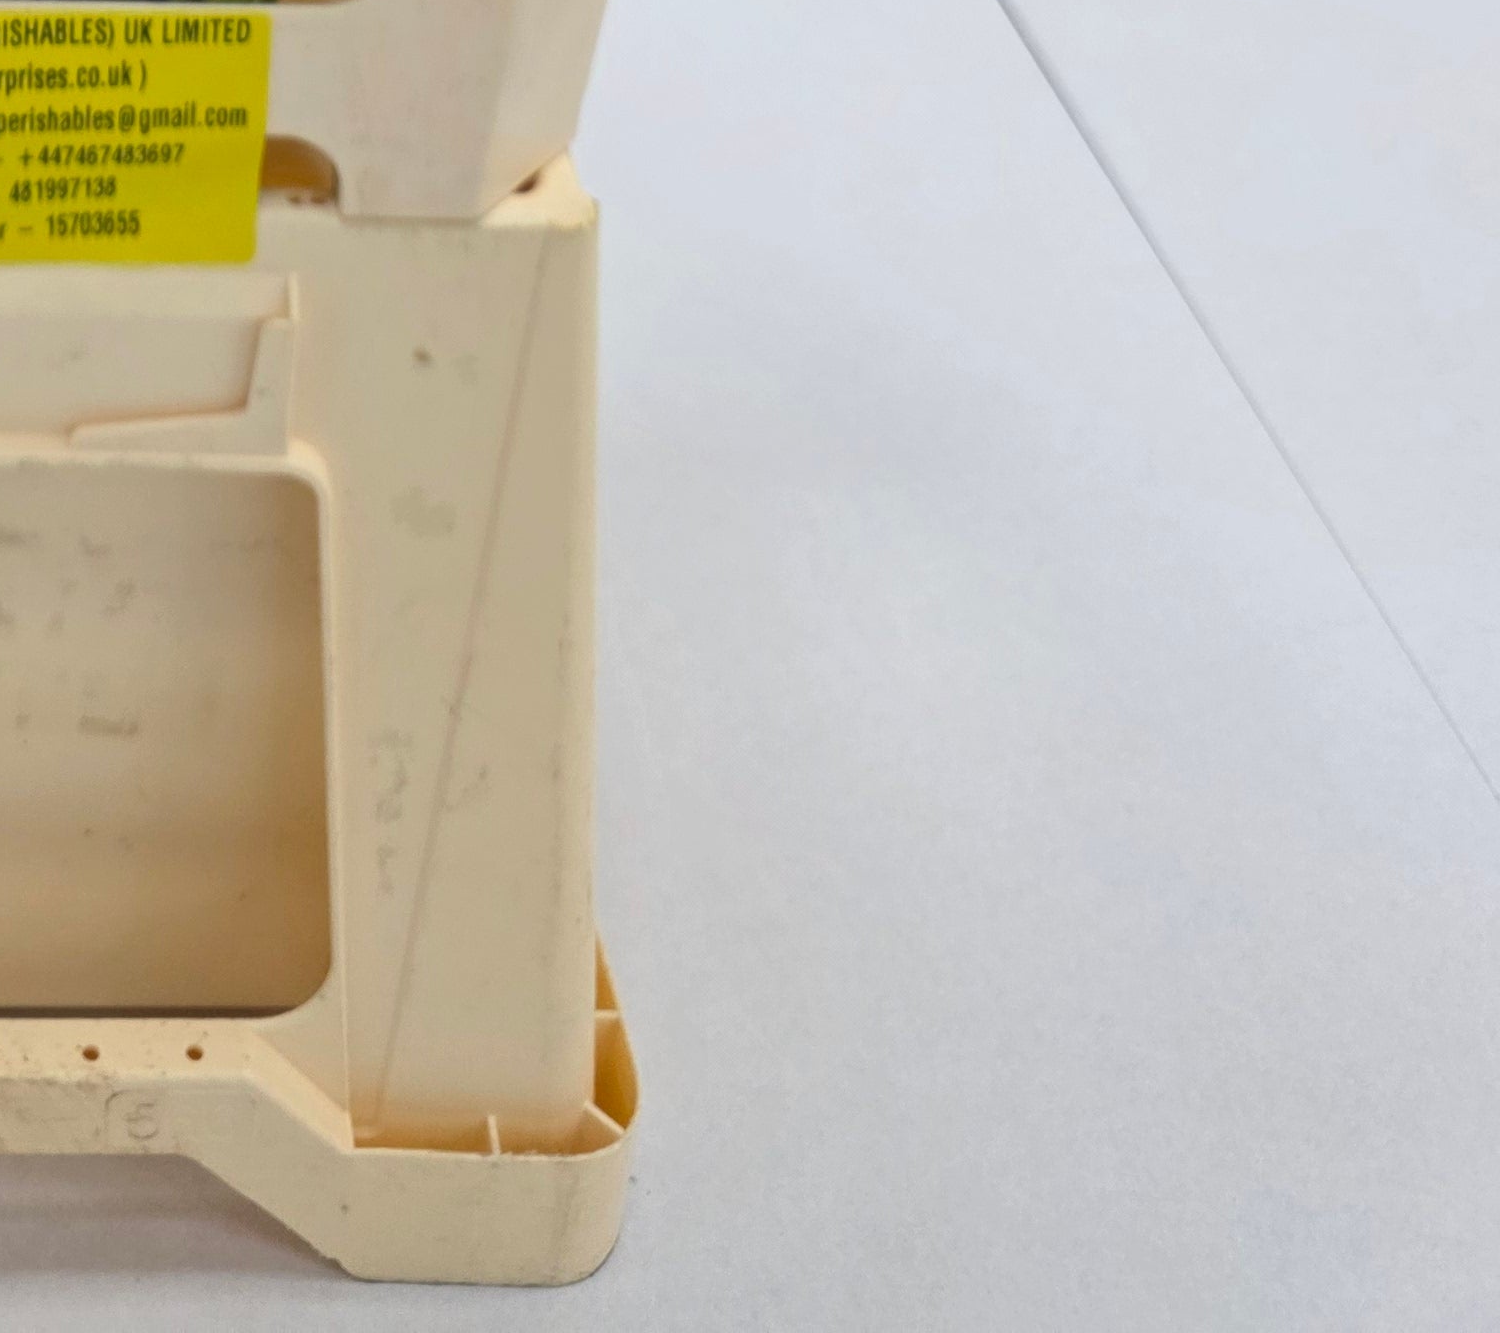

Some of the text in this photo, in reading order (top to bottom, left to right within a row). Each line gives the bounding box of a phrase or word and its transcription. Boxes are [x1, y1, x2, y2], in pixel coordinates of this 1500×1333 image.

[124, 19, 152, 45] UK
[162, 18, 251, 44] LIMITED
[139, 60, 147, 91] )
[20, 143, 184, 167] +447467483697
[9, 176, 116, 203] 481997138
[47, 210, 140, 238] 15703655
